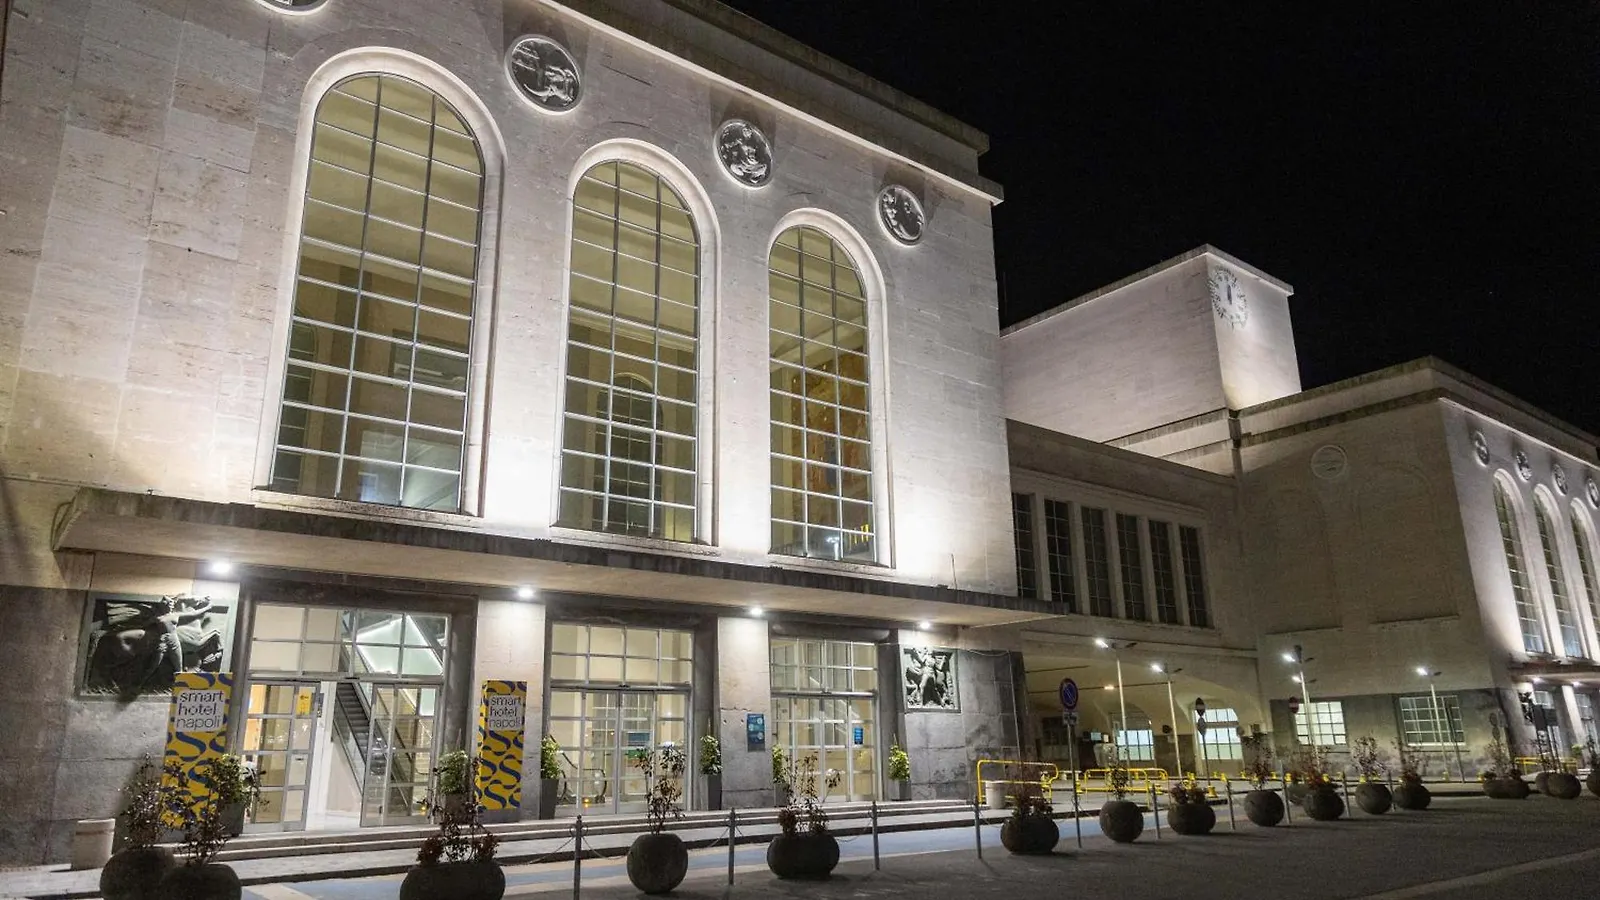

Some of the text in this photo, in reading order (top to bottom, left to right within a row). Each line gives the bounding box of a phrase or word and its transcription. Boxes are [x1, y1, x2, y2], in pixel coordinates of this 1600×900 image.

[180, 691, 224, 702] smart
[491, 696, 521, 705] smart
[178, 703, 217, 715] hotel
[490, 706, 517, 717] hotel
[177, 716, 221, 730] napoli
[489, 717, 520, 729] napoli
